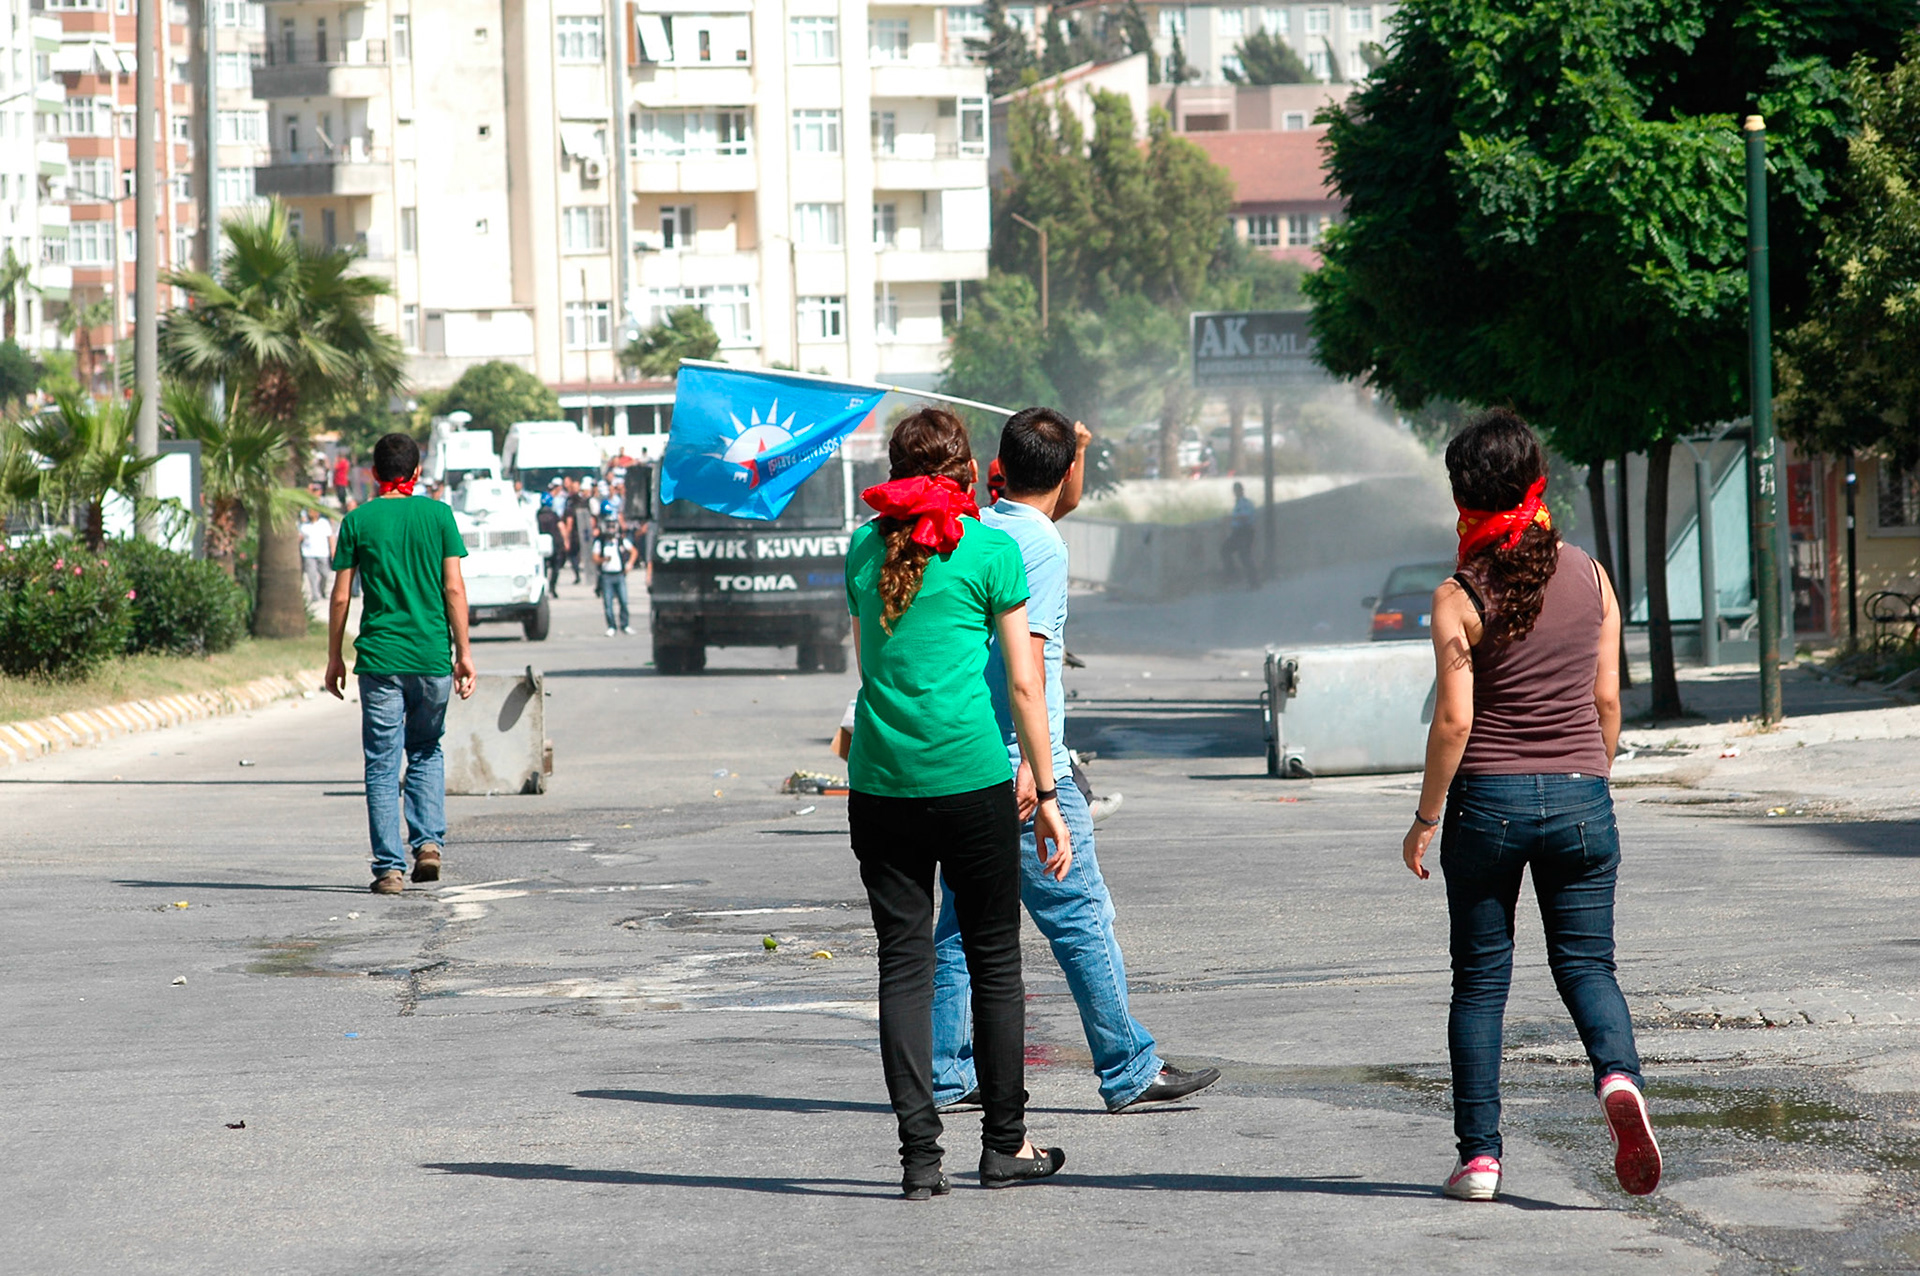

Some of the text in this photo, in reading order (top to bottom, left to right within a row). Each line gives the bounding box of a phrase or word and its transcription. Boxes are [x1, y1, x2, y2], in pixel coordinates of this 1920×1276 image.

[1198, 318, 1321, 357] AK EMLA
[656, 536, 849, 563] ÇEVİK KUVVET
[714, 574, 797, 591] TOMA
